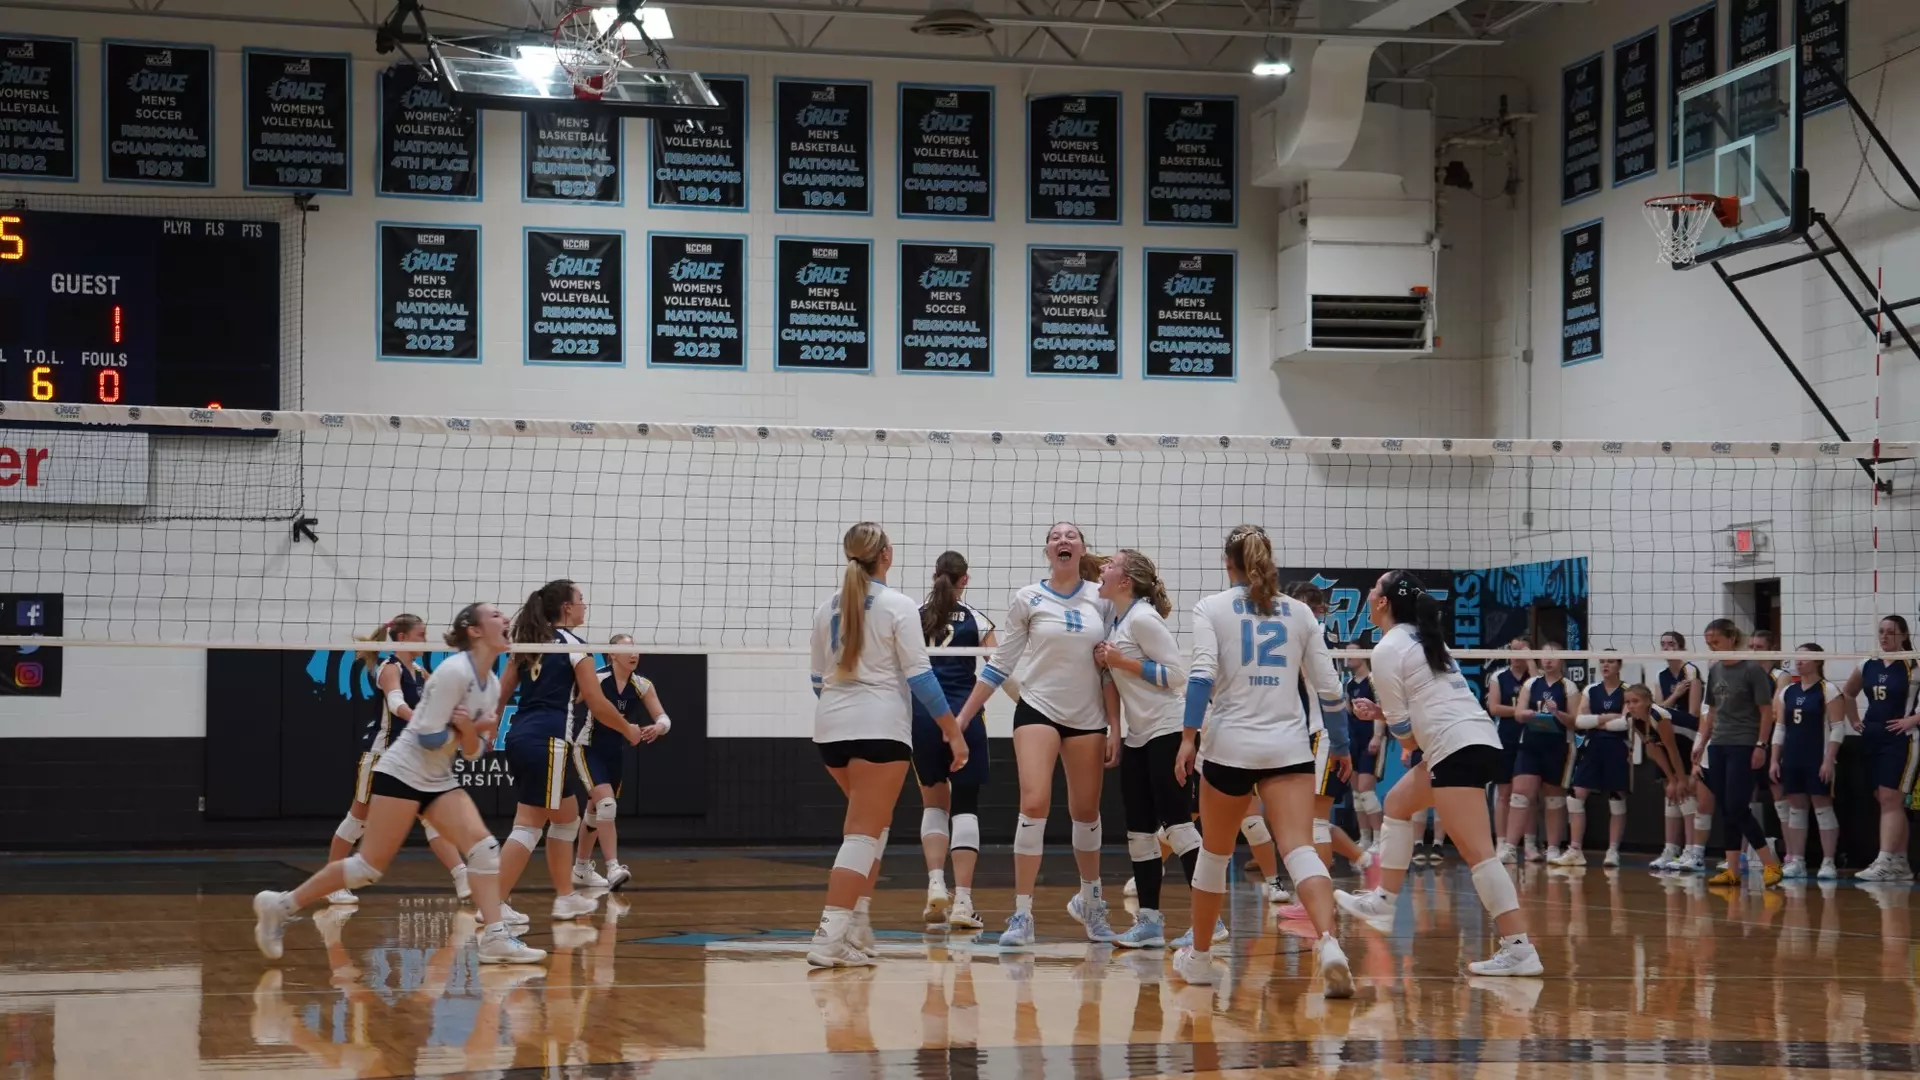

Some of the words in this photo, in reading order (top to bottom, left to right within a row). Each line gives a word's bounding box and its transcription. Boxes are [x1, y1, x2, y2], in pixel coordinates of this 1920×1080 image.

[1810, 10, 1830, 25] MEN'S
[1801, 22, 1839, 45] BASKETBALL
[127, 69, 188, 92] GRACE
[265, 76, 326, 101] GRACE
[0, 102, 59, 115] LLEYBALL
[141, 95, 177, 107] MEN'S
[135, 109, 182, 121] SOCCER
[271, 103, 325, 116] WOMEN'S
[404, 111, 453, 123] WOMEN'
[796, 104, 850, 127] GRACE
[0, 118, 63, 134] ATIONAL
[261, 116, 334, 130] VOLLEYBALL
[557, 118, 590, 129] MEN'S
[919, 110, 973, 133] GRACE
[1047, 115, 1100, 138] GRACE
[121, 124, 198, 140] REGIONAL
[396, 124, 465, 137] VOLLEYBALL
[539, 130, 608, 143] BASKETBALL
[808, 129, 839, 140] MEN'S
[1164, 119, 1217, 142] GRACE
[14, 135, 65, 151] PLACE
[261, 132, 336, 148] REGIONAL
[665, 136, 733, 149] VOLLEYBALL
[922, 134, 971, 145] WOMEN'S
[1050, 140, 1099, 151] WOMEN'S
[111, 140, 206, 158] CHAMPIONS
[394, 140, 469, 156] NATIONAL
[537, 146, 611, 161] NATIONAL
[790, 142, 857, 153] BASKETBALL
[914, 148, 979, 159] VOLLEYBALL
[1176, 143, 1206, 154] MEN'S
[0, 154, 47, 171] 1992
[252, 148, 344, 166] CHAMPIONS
[391, 155, 420, 169] 4TH
[422, 157, 470, 172] PLACE
[665, 152, 734, 167] REGIONAL
[788, 157, 860, 172] NATIONAL
[1042, 153, 1106, 164] VOLLEYBALL
[1160, 156, 1223, 167] BASKETBALL
[136, 160, 184, 177] 1993
[275, 167, 322, 184] 1993
[532, 161, 616, 177] RUNNER-UP
[656, 168, 741, 184] CHAMPIONS
[912, 162, 981, 177] REGIONAL
[1040, 167, 1109, 182] NATIONAL
[408, 175, 453, 191] 1993
[782, 173, 865, 188] CHAMPIONS
[904, 177, 988, 194] CHAMPIONS
[1158, 171, 1225, 185] REGIONAL
[553, 181, 596, 197] 1993
[677, 186, 722, 203] 1994
[1038, 183, 1065, 196] 5TH
[1067, 184, 1110, 197] PLACE
[1150, 186, 1231, 201] CHAMPIONS
[802, 191, 846, 207] 1994
[925, 195, 968, 212] 1995
[1054, 200, 1096, 217] 1995
[1171, 203, 1212, 219] 1995
[163, 220, 191, 235] PLYR
[205, 222, 224, 236] FLS
[242, 224, 262, 238] PTS
[400, 248, 458, 273] GRACE
[545, 253, 602, 278] GRACE
[668, 257, 725, 282] GRACE
[795, 261, 851, 286] GRACE
[51, 273, 120, 295] GUEST
[413, 275, 447, 285] MEN'S
[549, 279, 601, 290] WOMEN'S
[918, 266, 973, 290] GRACE
[1048, 270, 1101, 293] GRACE
[1163, 273, 1216, 296] GRACE
[408, 288, 452, 299] SOCCER
[672, 283, 723, 294] WOMEN'S
[808, 287, 840, 298] MEN'S
[1572, 287, 1592, 300] SOCCER
[541, 292, 610, 304] VOLLEYBALL
[664, 296, 731, 308] VOLLEYBALL
[930, 291, 962, 302] MEN'S
[1051, 294, 1099, 305] WOMEN'S
[1175, 298, 1206, 307] MEN'S
[396, 301, 469, 316] NATIONAL
[542, 306, 613, 320] REGIONAL
[790, 300, 857, 312] BASKETBALL
[925, 304, 967, 315] SOCCER
[1043, 307, 1107, 318] VOLLEYBALL
[665, 309, 735, 324] NATIONAL
[789, 313, 859, 327] REGIONAL
[1158, 310, 1222, 321] BASKETBALL
[114, 306, 121, 343] 1
[420, 318, 466, 331] PLACE
[534, 322, 617, 336] CHAMPIONS
[656, 324, 697, 338] FINAL
[700, 325, 738, 339] FOUR
[912, 319, 981, 333] REGIONAL
[1042, 322, 1109, 336] REGIONAL
[1158, 325, 1224, 339] REGIONAL
[405, 334, 455, 351] 2023
[781, 328, 866, 344] CHAMPIONS
[904, 334, 988, 349] CHAMPIONS
[551, 338, 600, 355] 2023
[673, 341, 721, 358] 2023
[1033, 337, 1116, 352] CHAMPIONS
[1149, 341, 1231, 354] CHAMPIONS
[24, 349, 64, 365] T.O.L.
[82, 352, 128, 367] FOULS
[799, 345, 847, 361] 2024
[924, 352, 971, 367] 2024
[1053, 354, 1099, 370] 2024
[1169, 357, 1214, 373] 2025
[32, 367, 53, 400] 6
[99, 369, 119, 402] 0
[54, 404, 81, 415] GRACE
[189, 409, 214, 420] GRACE
[320, 414, 344, 425] GRACE
[447, 418, 471, 428] GRACE
[571, 422, 595, 432] GRACE
[811, 429, 835, 439] GRACE
[1044, 433, 1066, 443] GRACE
[1270, 438, 1293, 448] GRACE
[1493, 440, 1514, 450] GRACE
[1711, 442, 1732, 451] GRACE
[1820, 443, 1840, 453] GRACE
[1064, 609, 1084, 632] 11
[1241, 619, 1288, 667] 12
[1249, 676, 1280, 687] TIGERS
[1872, 685, 1887, 701] 15
[1793, 708, 1802, 724] 5
